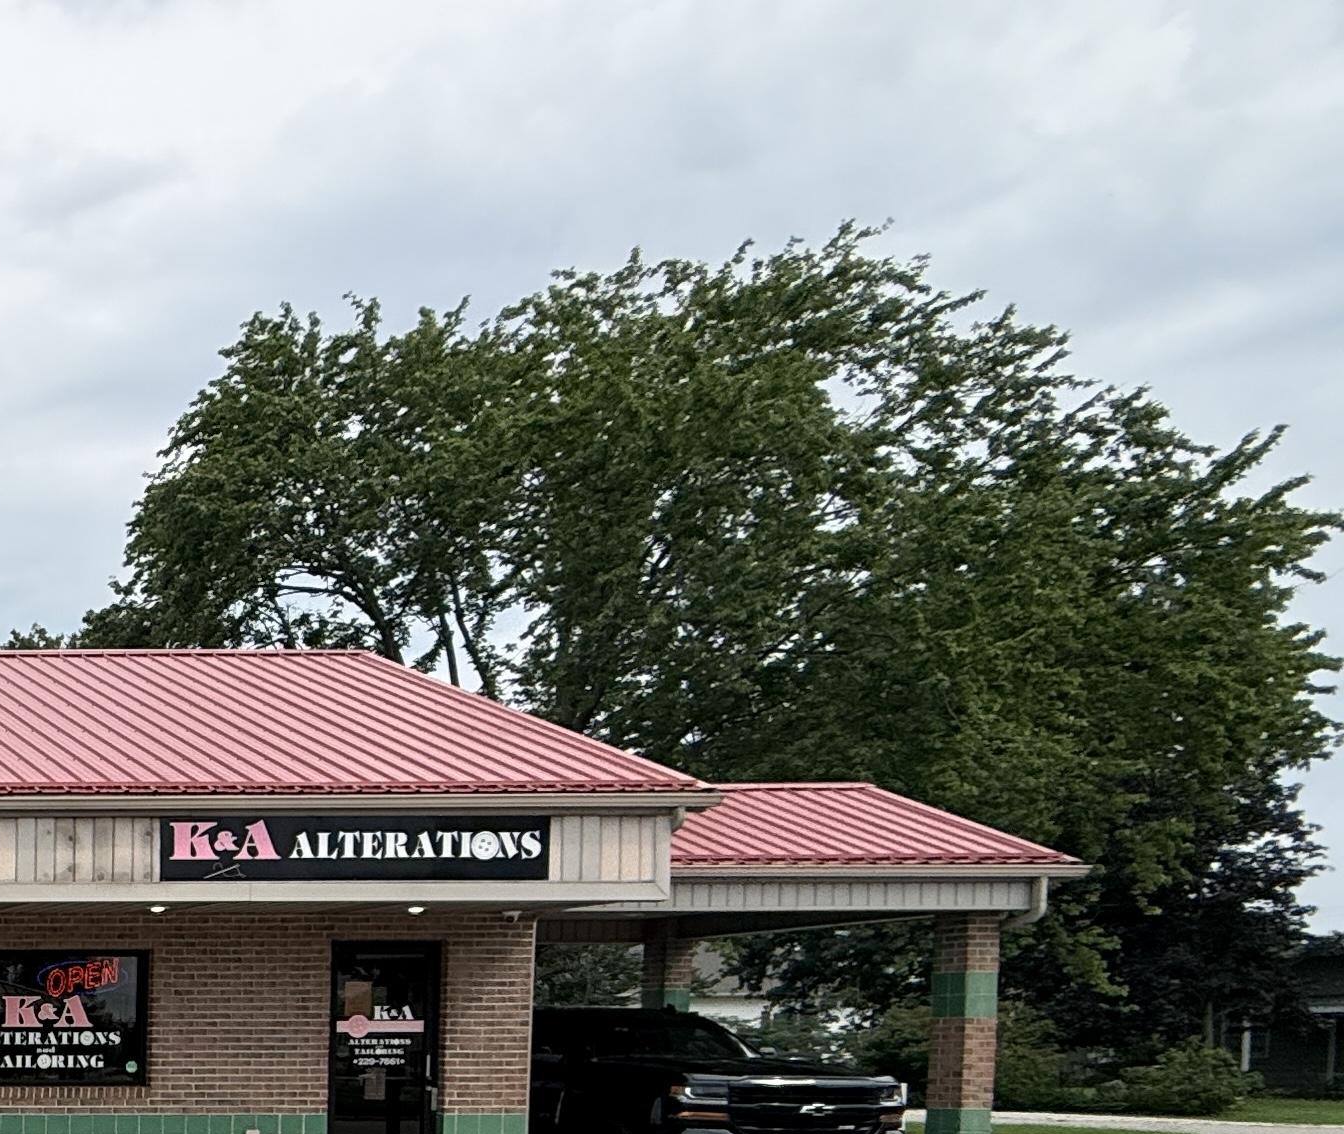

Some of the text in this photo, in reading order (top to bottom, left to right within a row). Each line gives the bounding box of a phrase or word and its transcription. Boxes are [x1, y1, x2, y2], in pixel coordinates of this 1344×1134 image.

[169, 819, 542, 861] K&A ALTERATIONS
[47, 958, 120, 997] OPEN
[1, 995, 94, 1028] K&A
[373, 1005, 414, 1020] K&A
